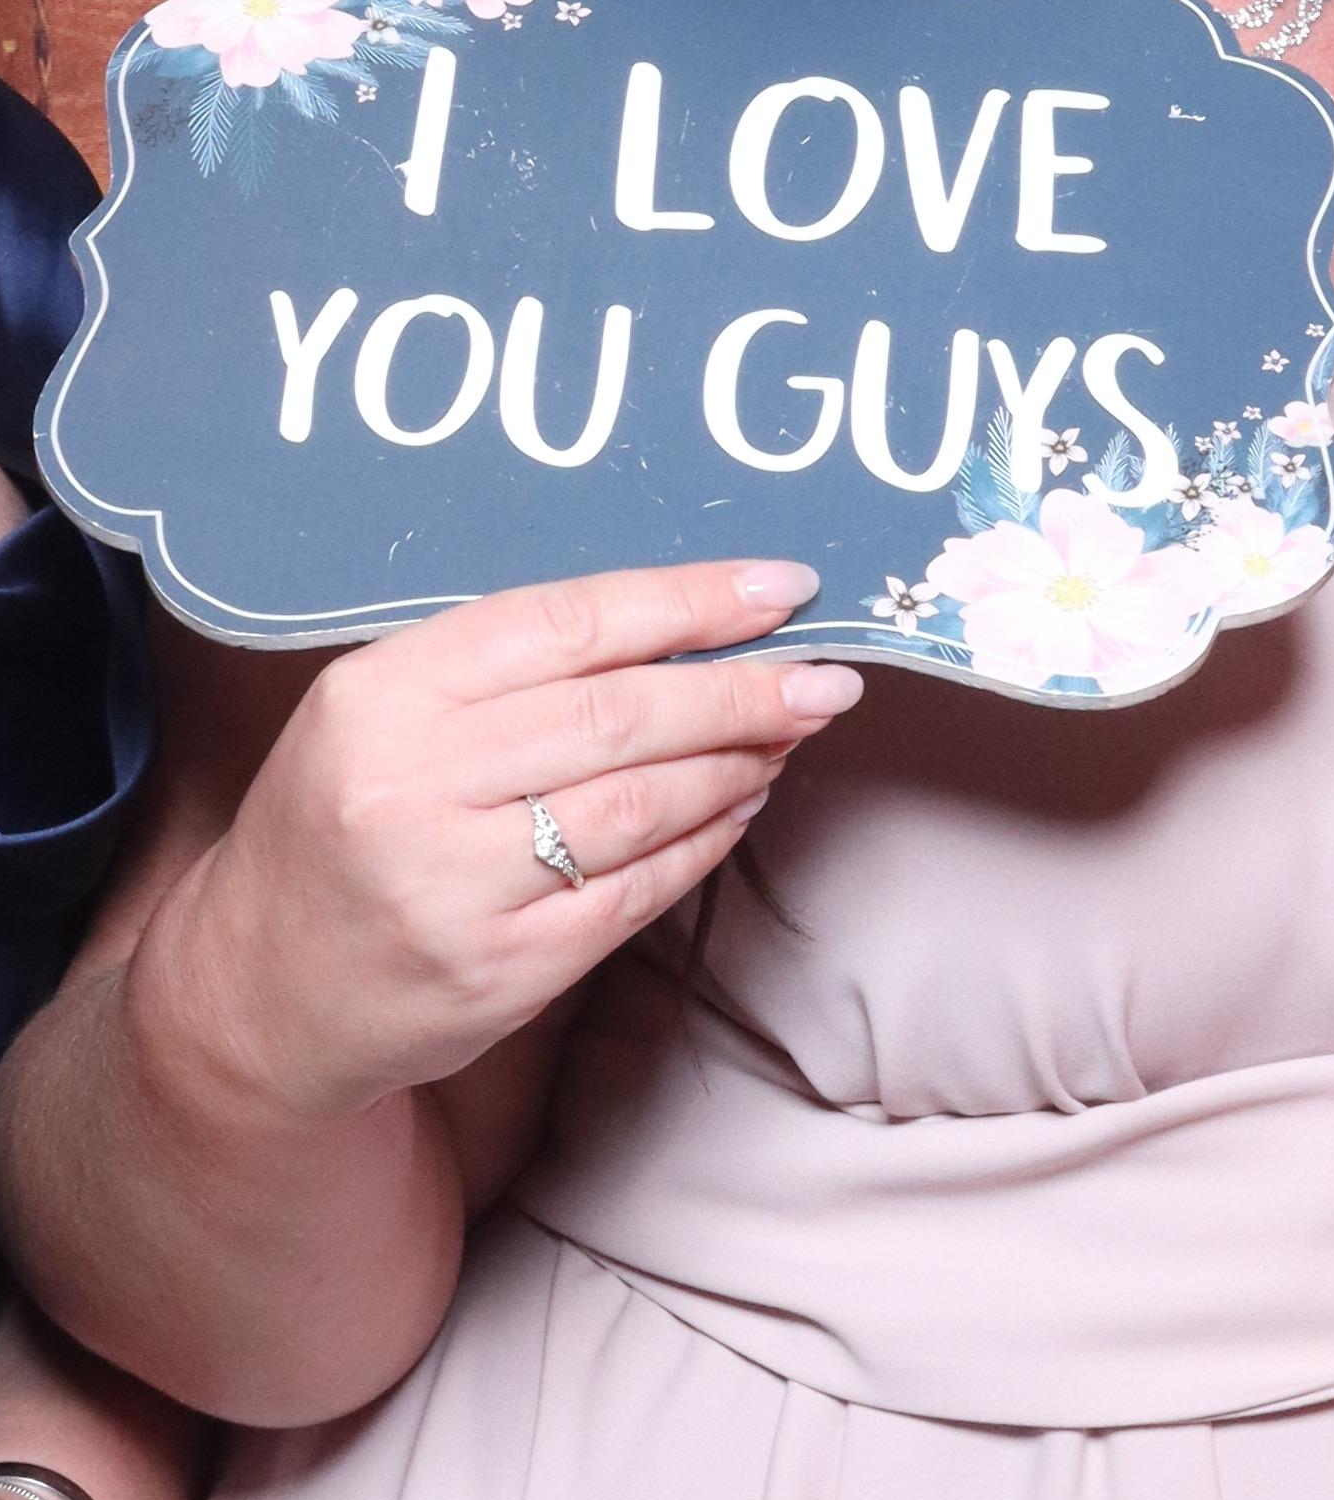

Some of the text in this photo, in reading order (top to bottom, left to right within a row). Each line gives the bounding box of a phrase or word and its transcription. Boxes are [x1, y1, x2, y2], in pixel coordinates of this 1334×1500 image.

[404, 46, 1110, 254] I LOVE
[270, 287, 1180, 505] YOU GUYS
